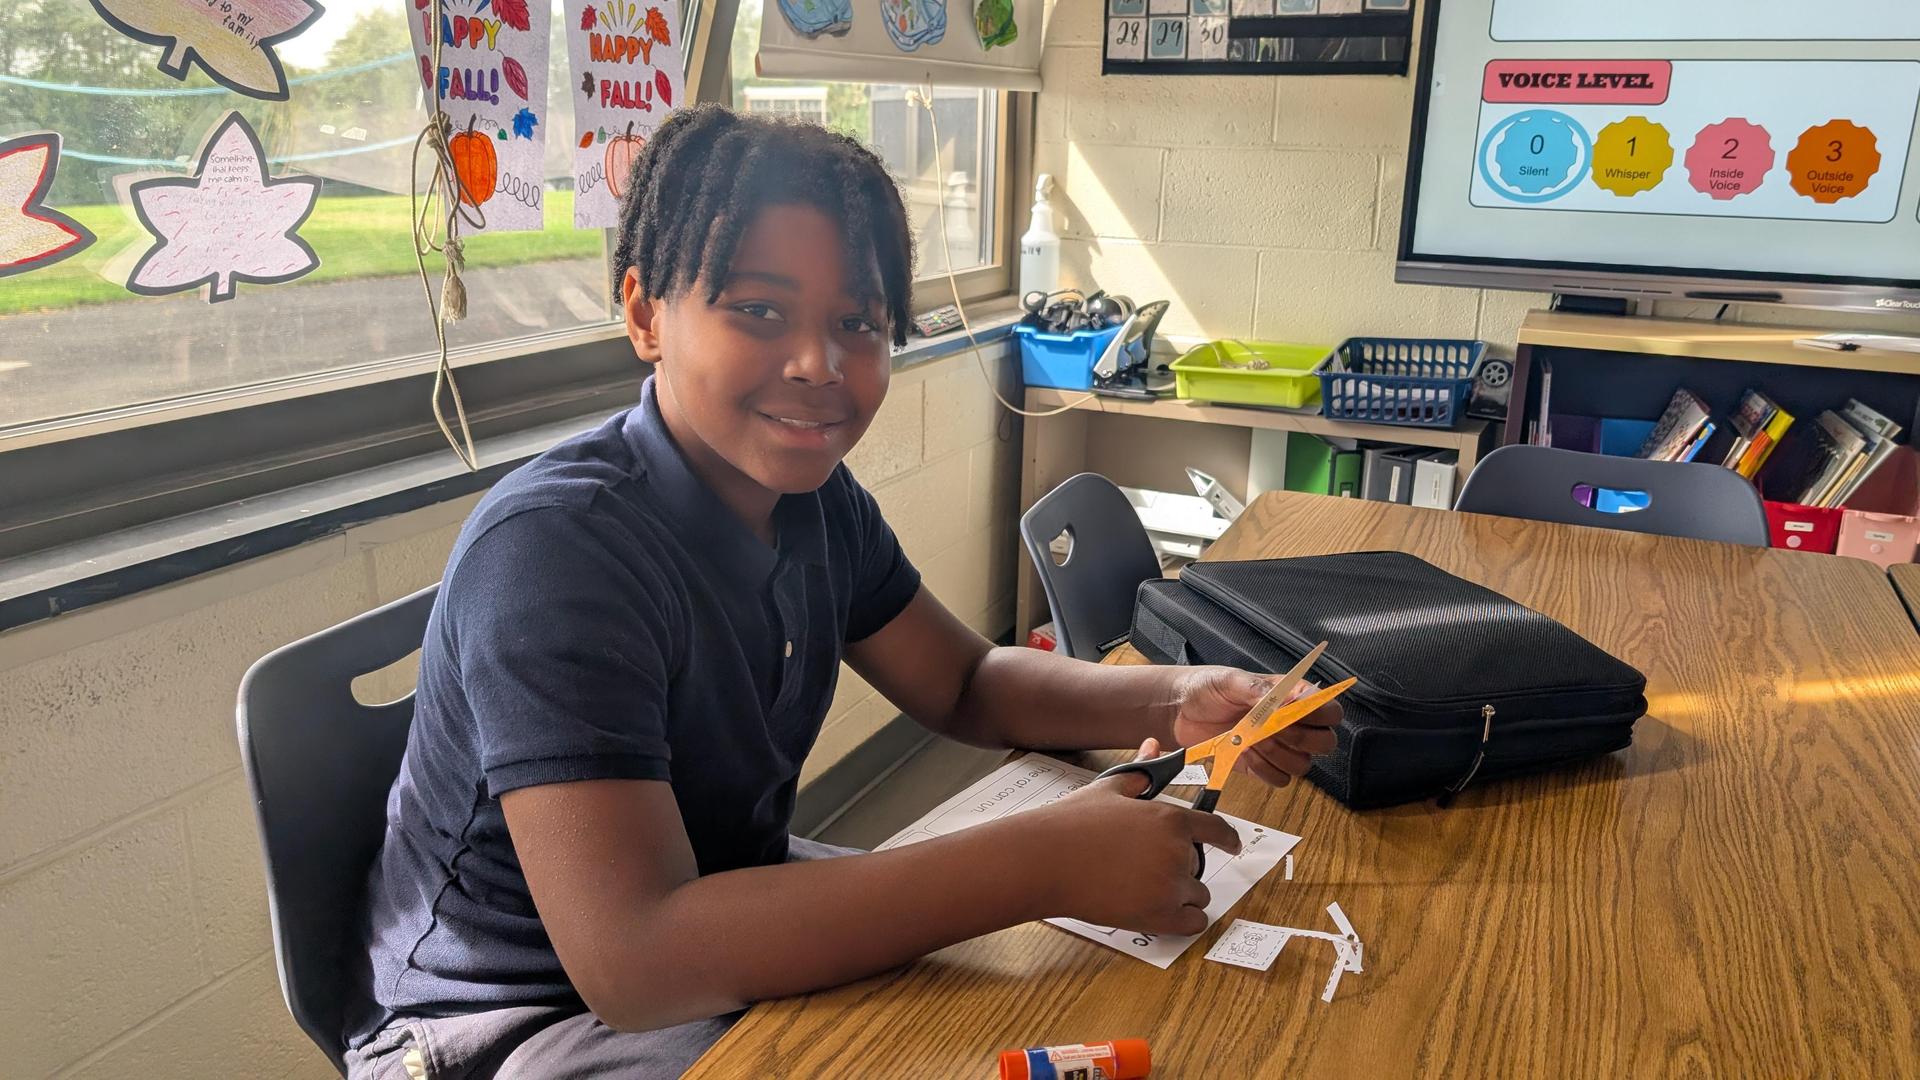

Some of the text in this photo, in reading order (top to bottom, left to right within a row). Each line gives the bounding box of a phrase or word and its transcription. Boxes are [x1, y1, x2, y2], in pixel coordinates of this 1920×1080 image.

[220, 1, 232, 12] to
[237, 12, 254, 26] my
[223, 15, 260, 50] family
[1116, 19, 1225, 47] 28 29 30
[589, 32, 653, 65] HAPPY
[438, 67, 499, 106] FALL!
[1498, 73, 1654, 89] VOICE LEVEL
[601, 79, 653, 113] FALL!
[1530, 134, 1544, 155] 0
[1626, 136, 1637, 157] 1
[1721, 138, 1739, 160] 2
[1825, 140, 1843, 162] 3
[224, 175, 242, 183] calm
[1518, 166, 1549, 177] Silent
[1605, 168, 1652, 181] Whisper
[1709, 168, 1744, 179] Inside
[1807, 170, 1854, 182] Outside
[1709, 180, 1741, 190] Voice
[1811, 183, 1845, 194] Voice
[970, 765, 1052, 813] The rat can run.
